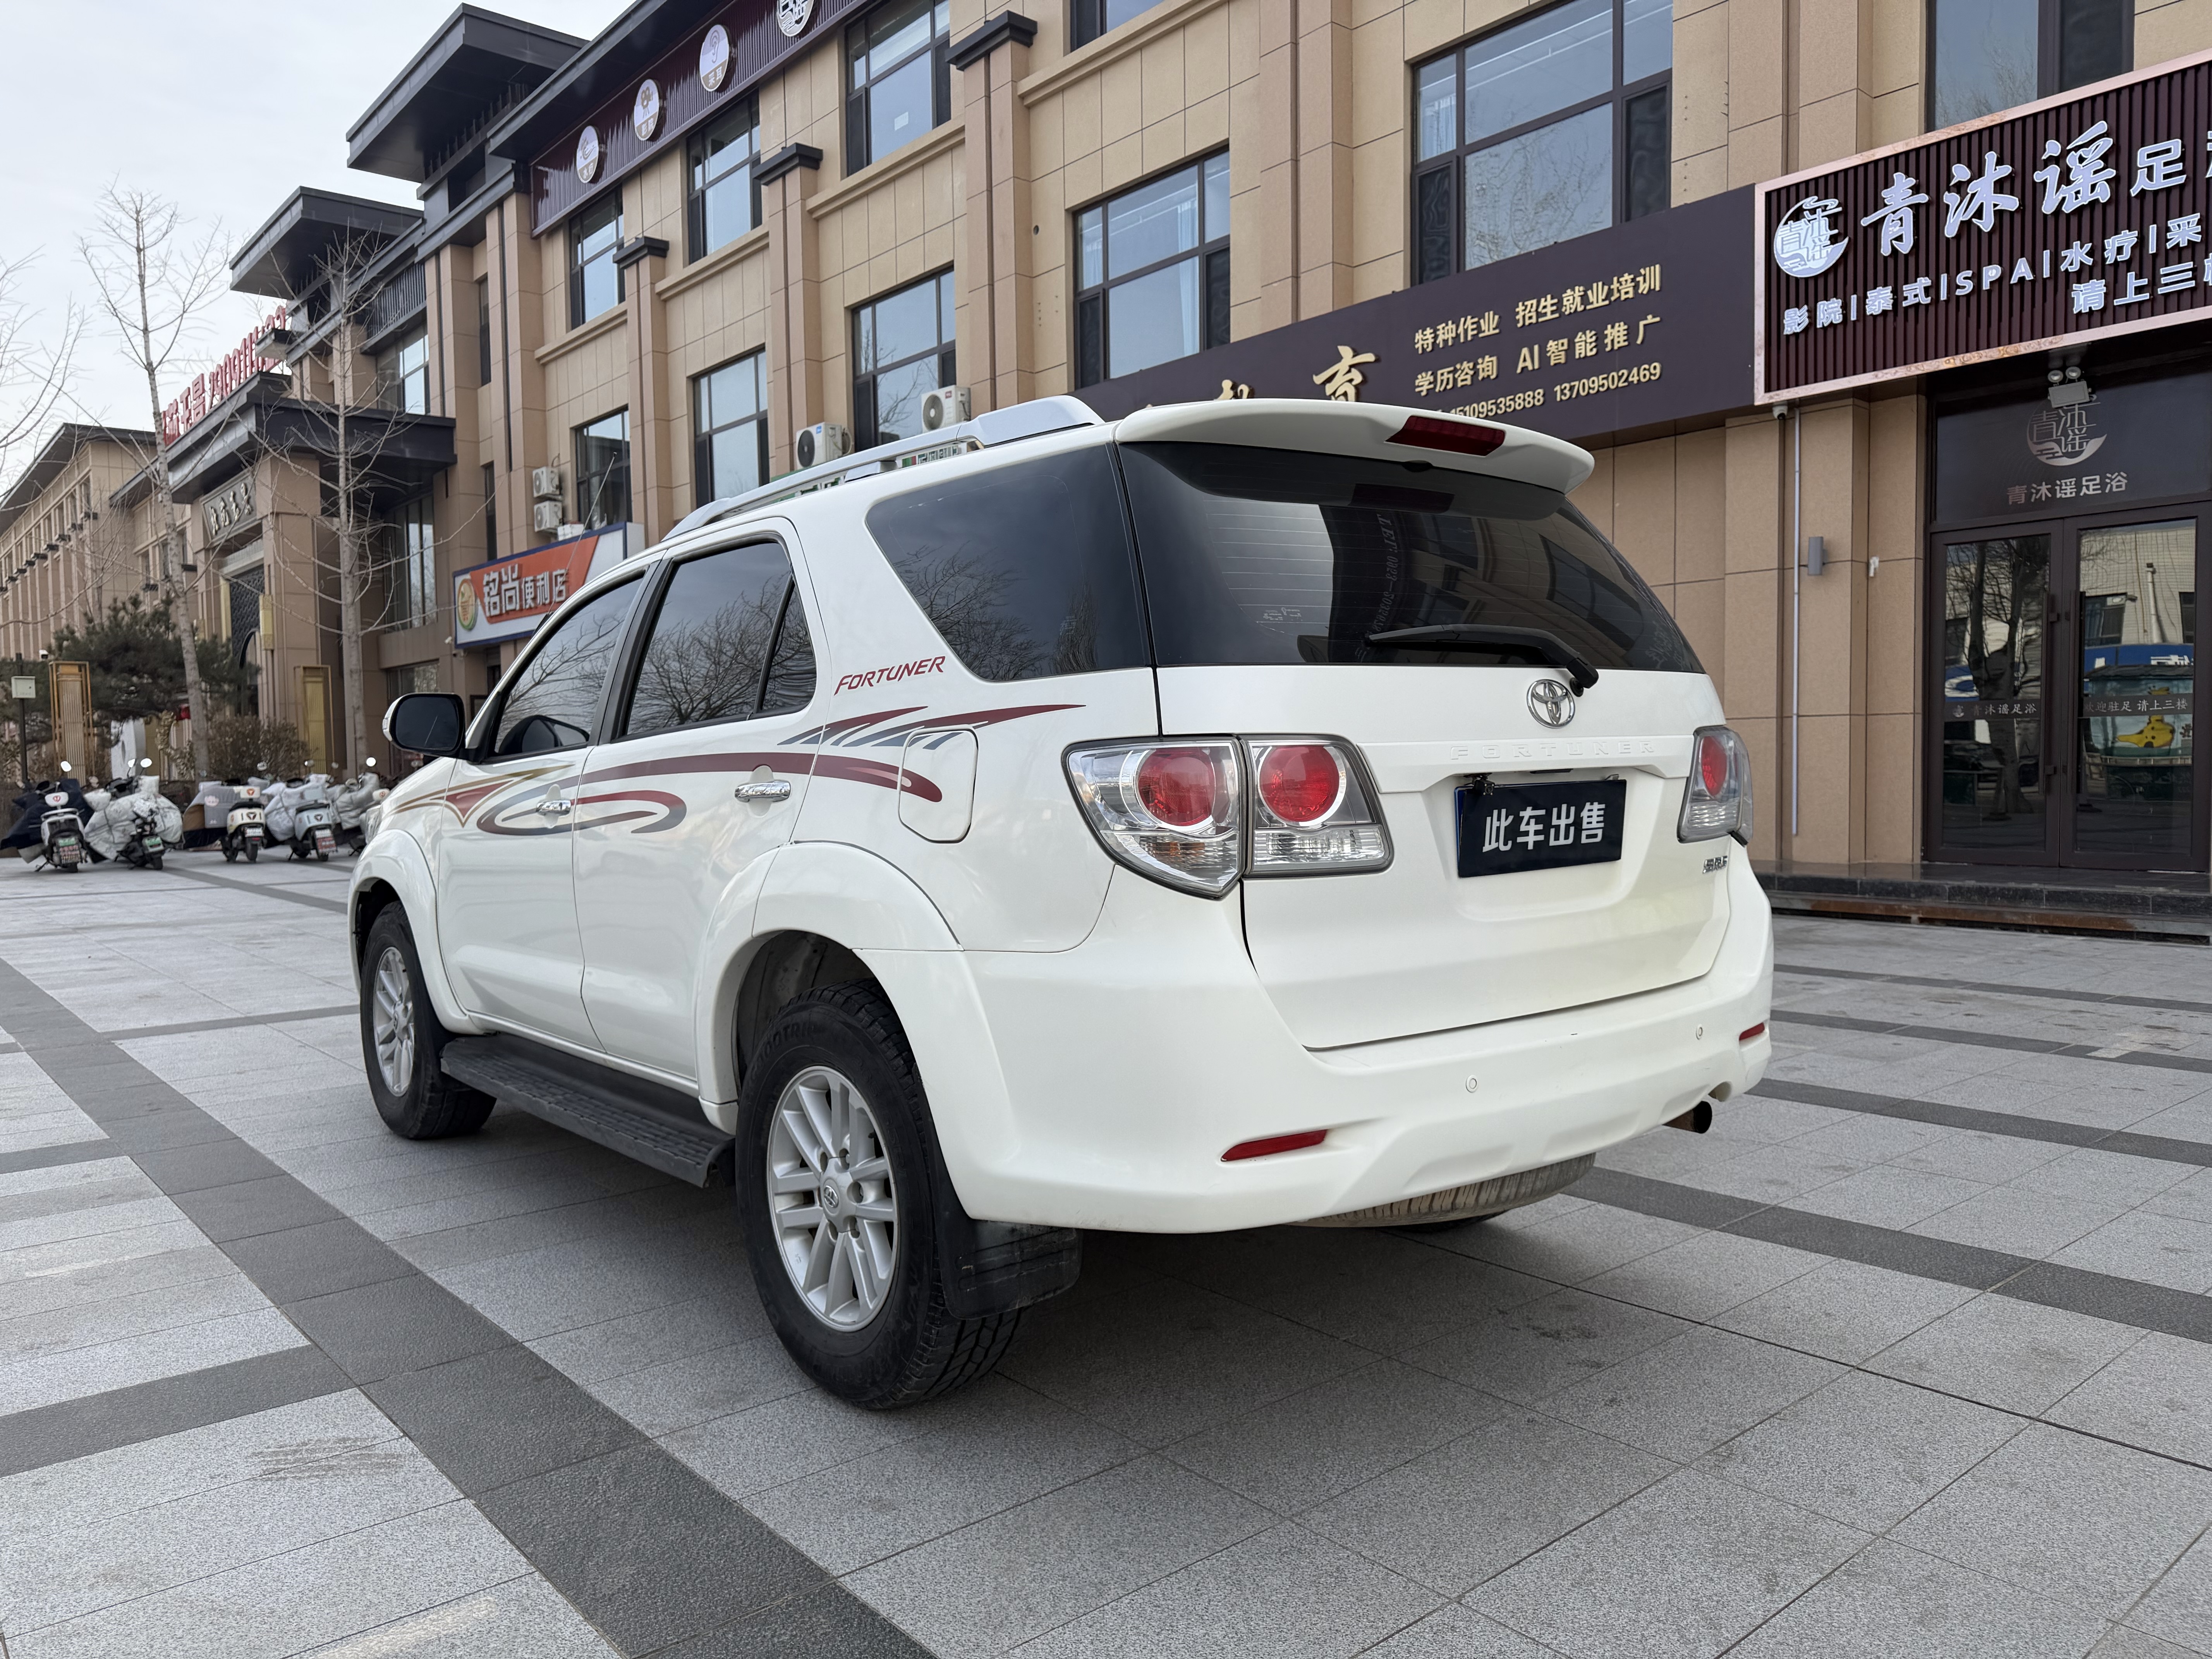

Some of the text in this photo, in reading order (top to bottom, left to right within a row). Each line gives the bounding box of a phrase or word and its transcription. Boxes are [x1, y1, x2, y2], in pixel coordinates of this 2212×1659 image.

[1860, 120, 2212, 256] 青沐谣足
[2072, 252, 2212, 314] 请上三
[1414, 264, 1662, 354] 特种作业 招生就业培训
[1414, 355, 1499, 397] 学历咨询
[1554, 362, 1662, 402] 13709502469
[2006, 471, 2128, 506] 青沐谣足浴
[483, 563, 567, 617] 铭尚便利店
[833, 656, 946, 696] FORTUNER
[2137, 698, 2188, 712] 请上三楼
[1450, 740, 1655, 760] FORTUNER
[1482, 802, 1606, 853] 此车出售
